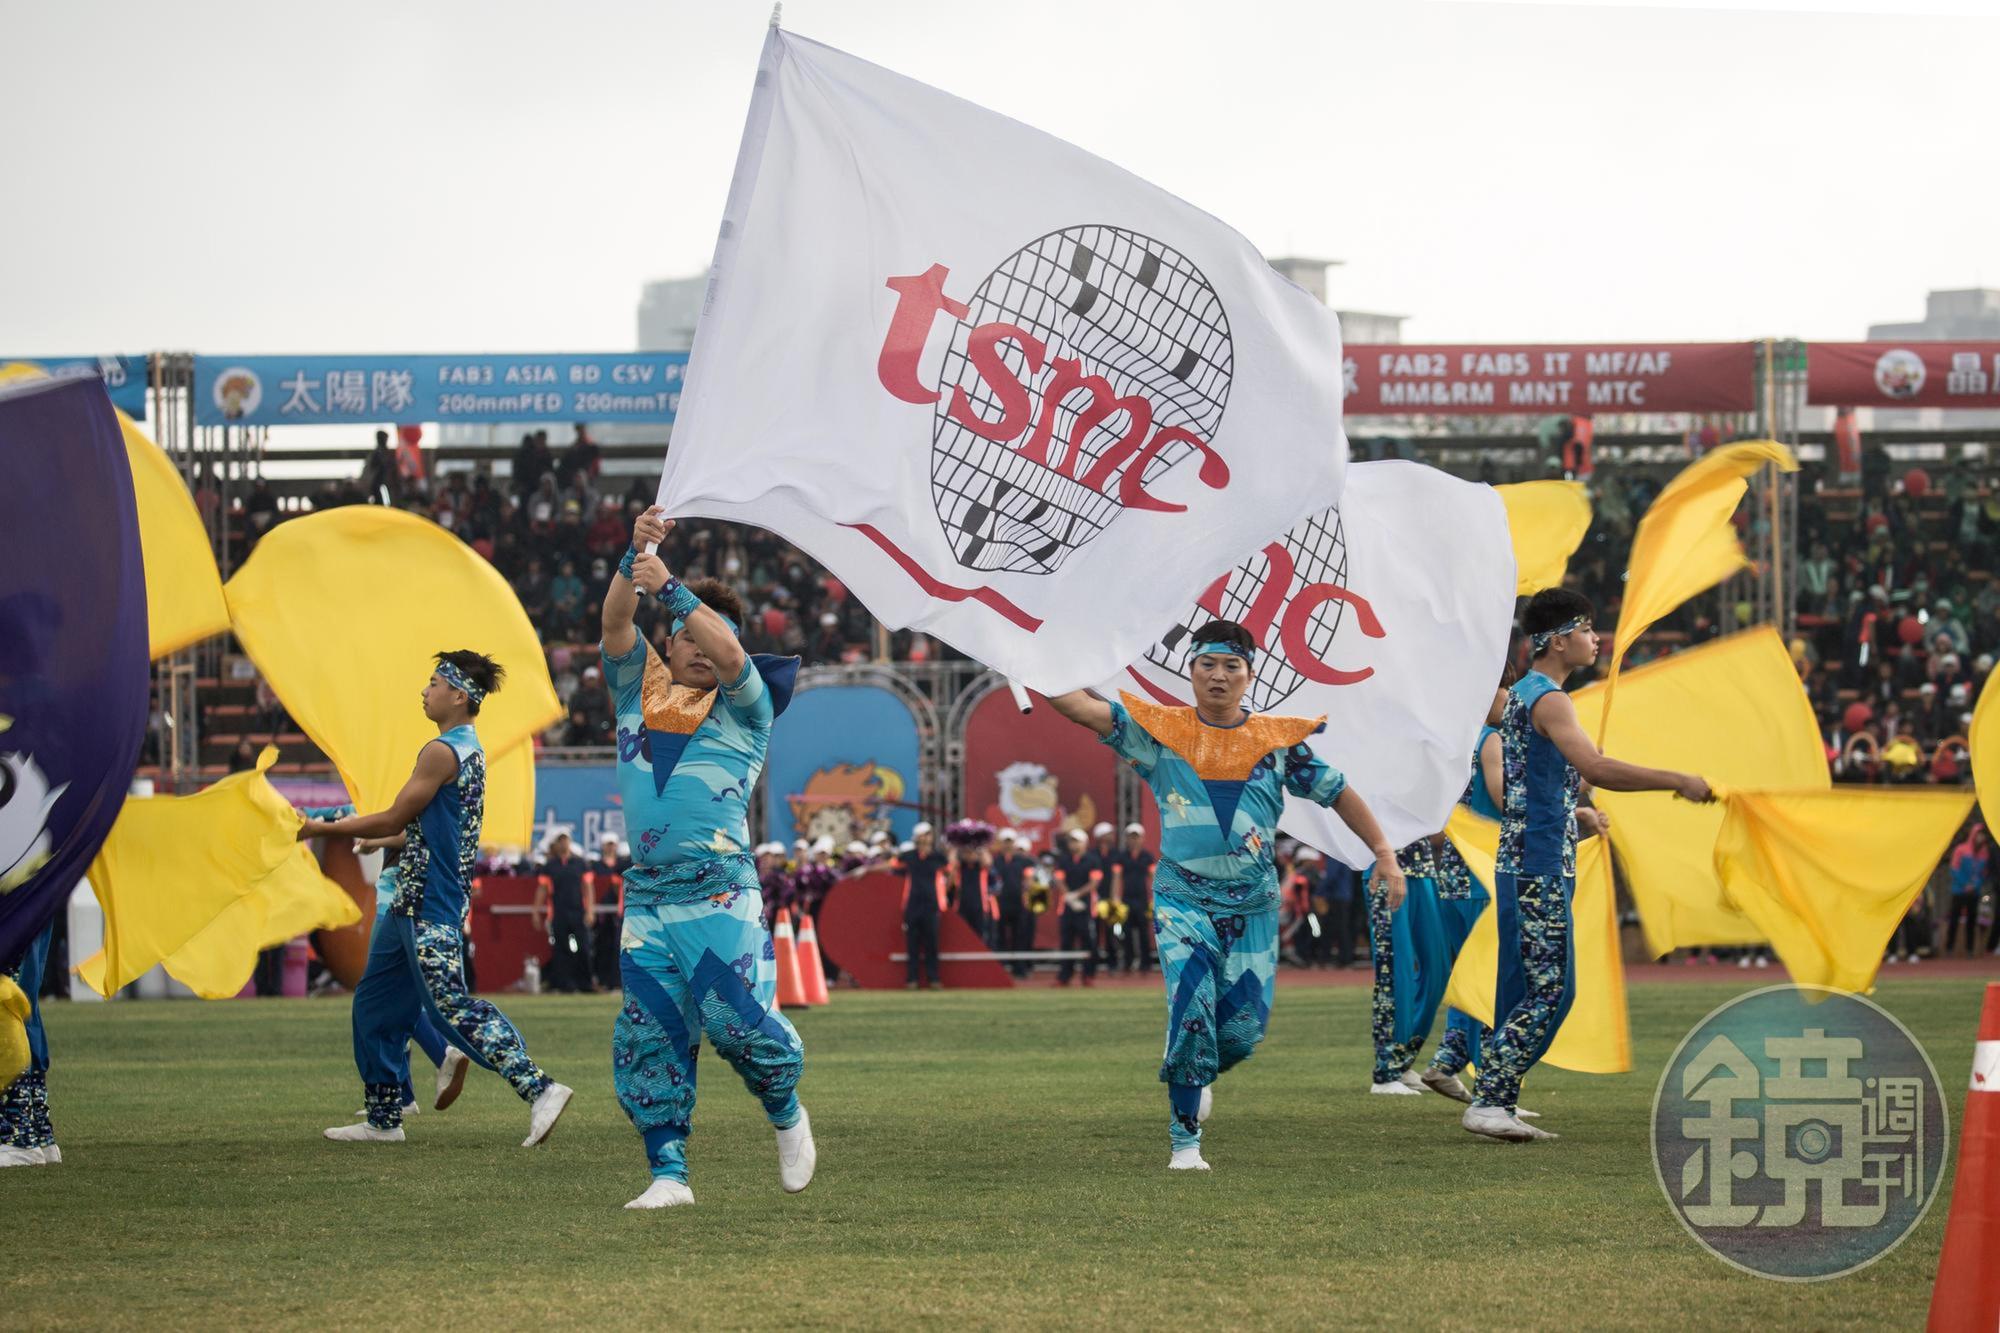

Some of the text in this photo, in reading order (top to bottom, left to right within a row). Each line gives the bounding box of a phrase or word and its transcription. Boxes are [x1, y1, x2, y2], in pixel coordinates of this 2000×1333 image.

[438, 365, 495, 385] FAB3
[504, 364, 558, 384] ASIA
[569, 364, 600, 383] BD
[611, 363, 656, 384] CSV
[1379, 354, 1448, 376] FAB2
[1543, 353, 1572, 375] IT
[1585, 352, 1673, 375] MF/AF
[1947, 352, 2000, 395] 晶
[278, 369, 415, 414] 太陽隊
[877, 262, 1231, 513] tsmc
[1379, 381, 1646, 406] MM&RM MNT MTC
[437, 393, 563, 414] 200mmPED
